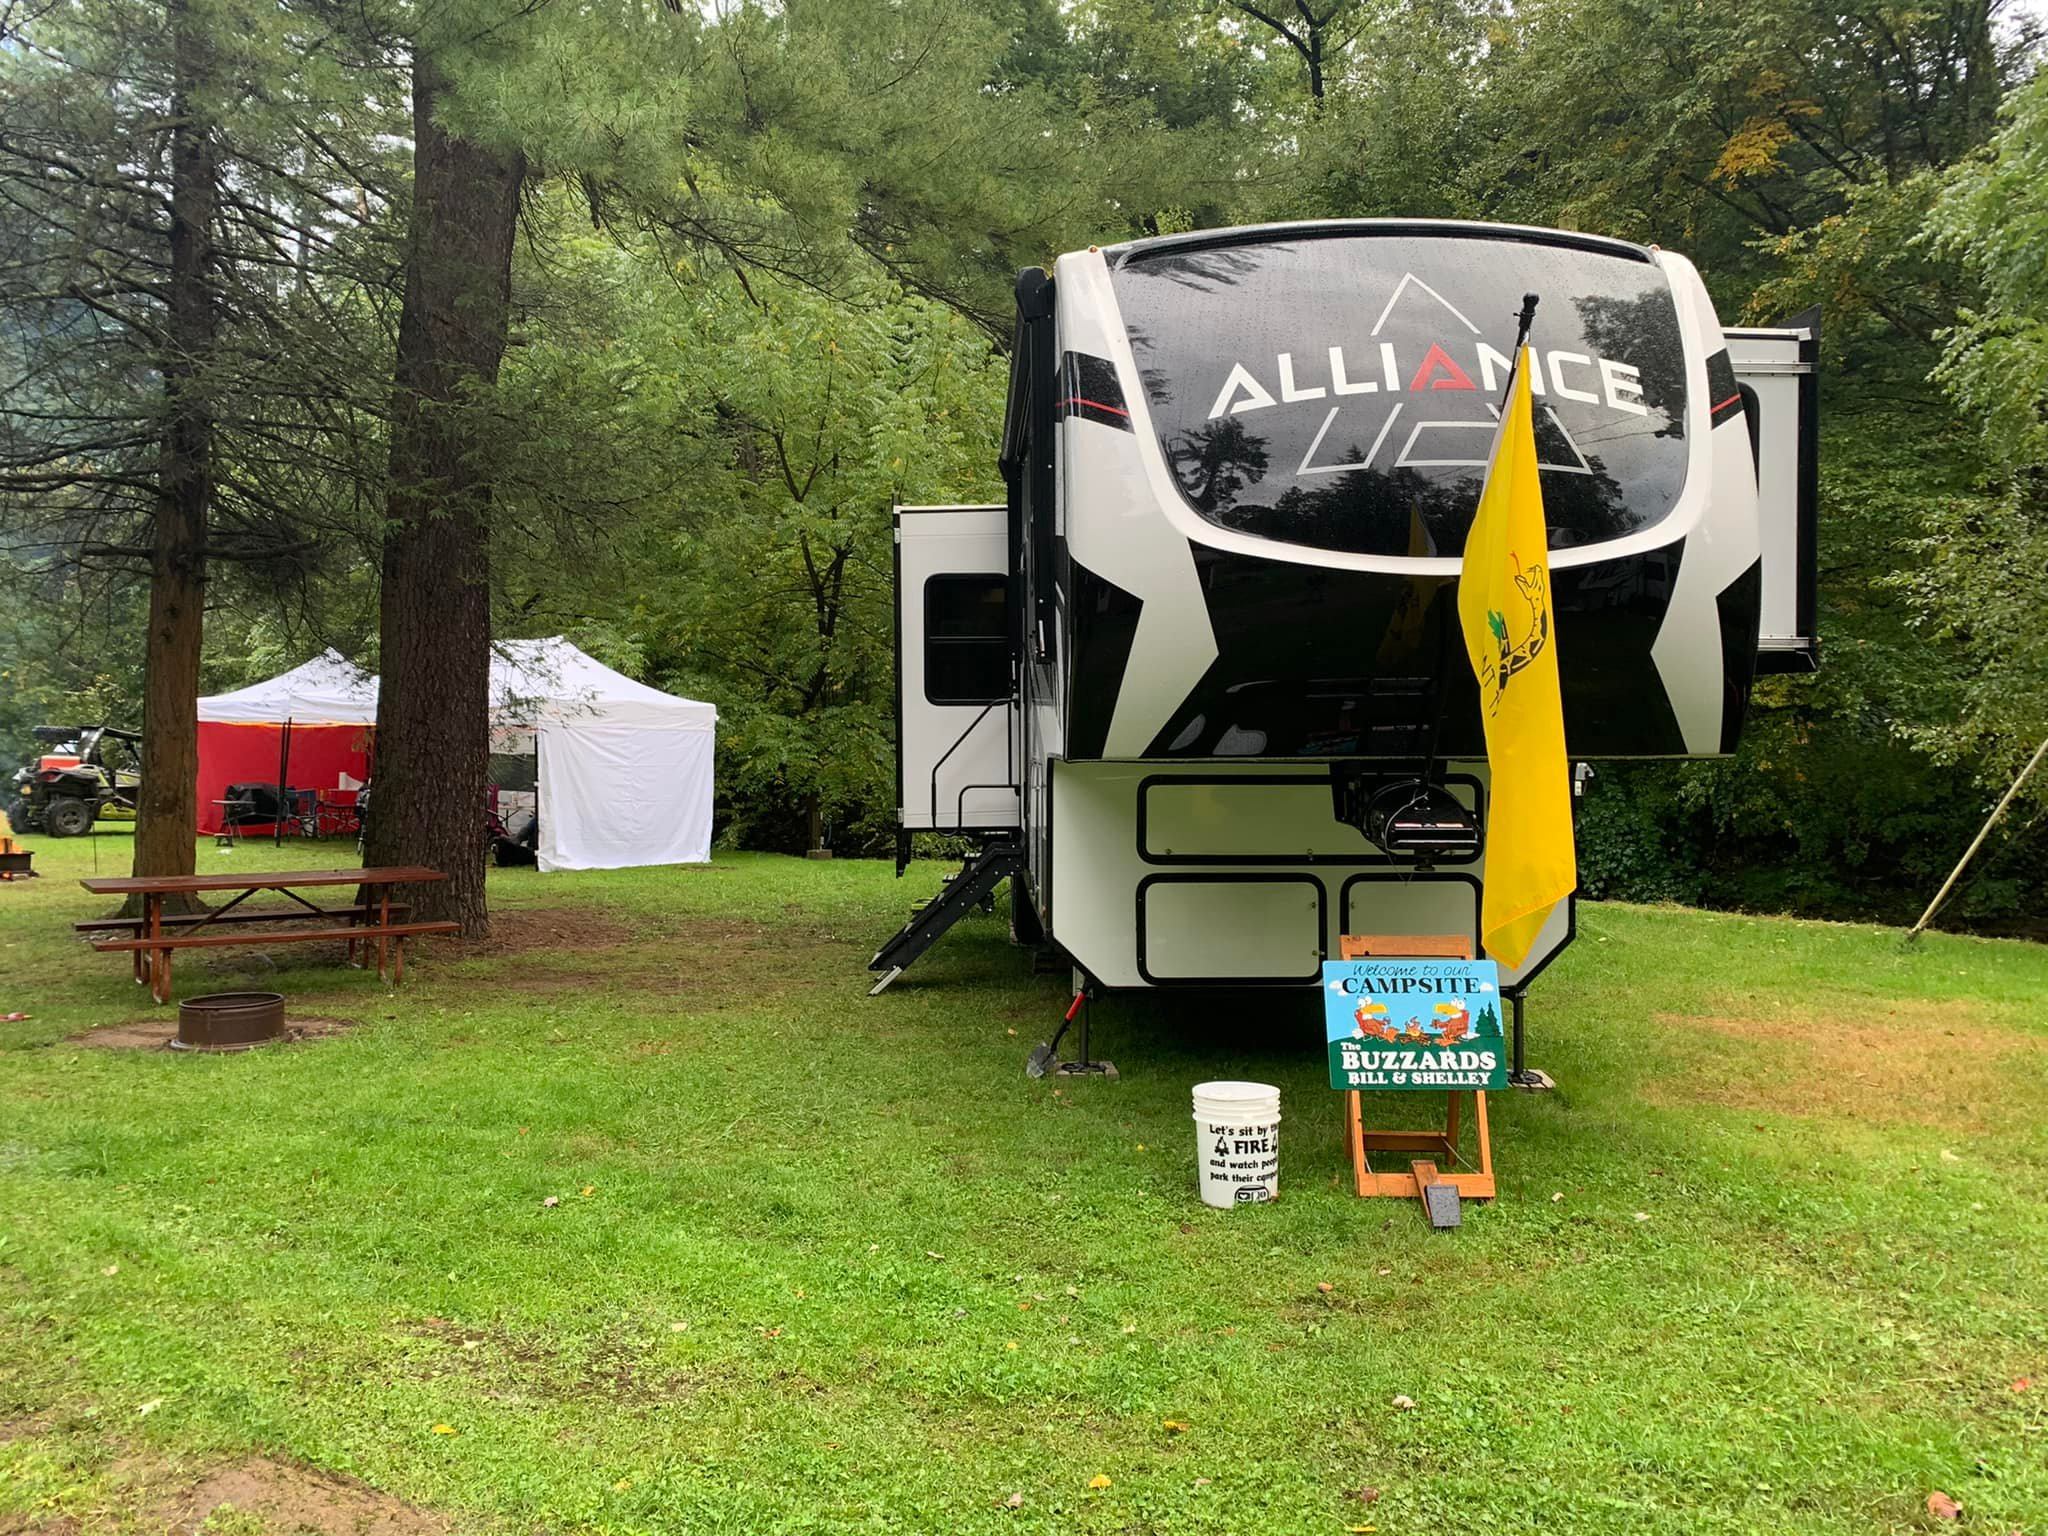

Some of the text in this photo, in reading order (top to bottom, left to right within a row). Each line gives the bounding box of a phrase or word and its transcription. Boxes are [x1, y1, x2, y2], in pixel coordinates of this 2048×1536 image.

[1208, 342, 1648, 418] ALLIANCE
[1353, 964, 1472, 976] Welcome to our
[1342, 977, 1481, 994] CAMPSITE
[1340, 1042, 1361, 1050] The
[1341, 1051, 1497, 1070] BUZZARDS
[1348, 1072, 1491, 1085] BILL & SHELLEY
[1209, 1124, 1234, 1136] Let's
[1239, 1126, 1253, 1136] sit
[1257, 1126, 1268, 1137] by
[1233, 1138, 1269, 1154] FIRE
[1210, 1159, 1225, 1168] and
[1229, 1160, 1258, 1169] watch
[1210, 1172, 1229, 1181] park
[1232, 1174, 1254, 1182] their
